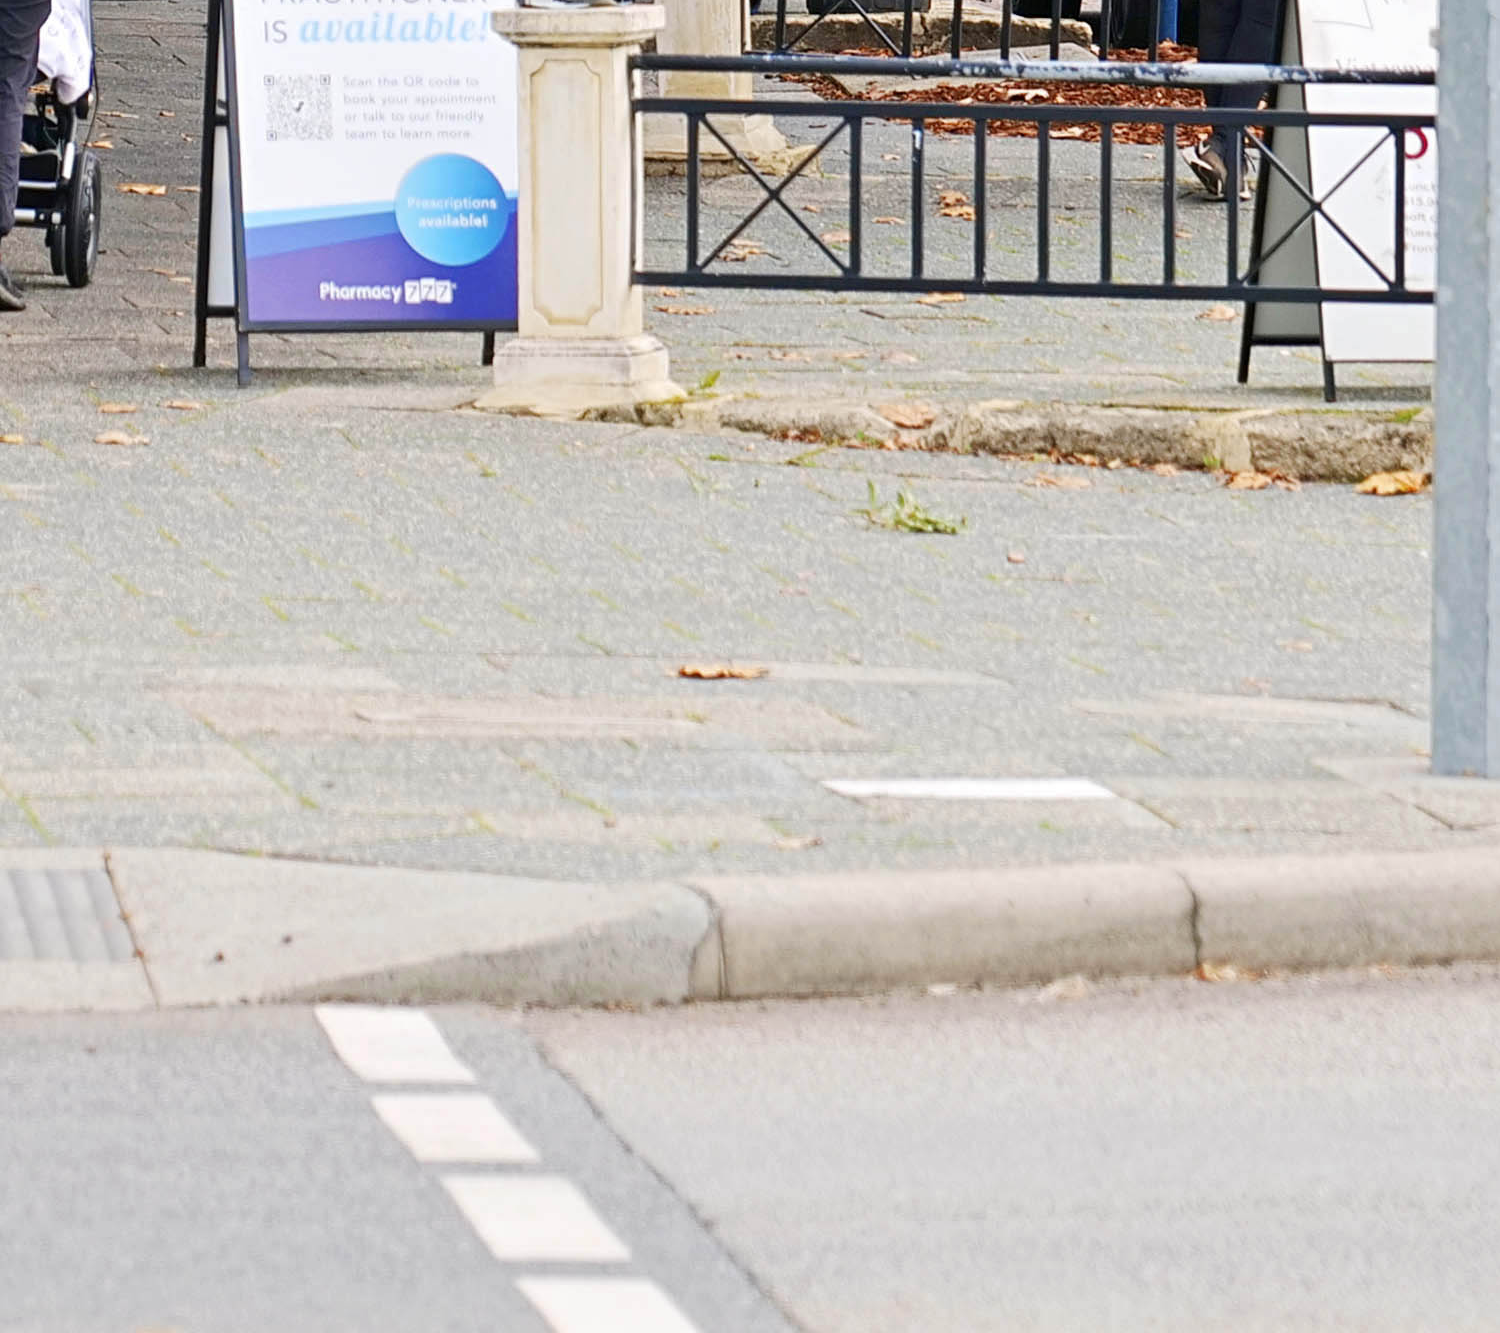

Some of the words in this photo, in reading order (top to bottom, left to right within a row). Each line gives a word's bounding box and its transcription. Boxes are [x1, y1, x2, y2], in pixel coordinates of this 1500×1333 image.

[264, 20, 288, 44] IS
[299, 11, 490, 44] available!
[343, 76, 372, 87] Scan
[377, 76, 399, 87] the
[403, 75, 424, 88] QR
[428, 75, 460, 87] code
[466, 76, 480, 87] to
[343, 93, 376, 105] book
[382, 95, 408, 107] your
[415, 94, 497, 107] appointment
[345, 111, 357, 122] or
[363, 110, 385, 122] talk
[391, 111, 404, 122] to
[409, 112, 430, 122] our
[435, 109, 485, 124] friendly
[345, 128, 377, 140] team
[382, 128, 396, 140] to
[401, 127, 433, 140] learn
[407, 195, 497, 212] Prescriptions
[419, 213, 488, 229] available!
[319, 280, 403, 305] Pharmacy
